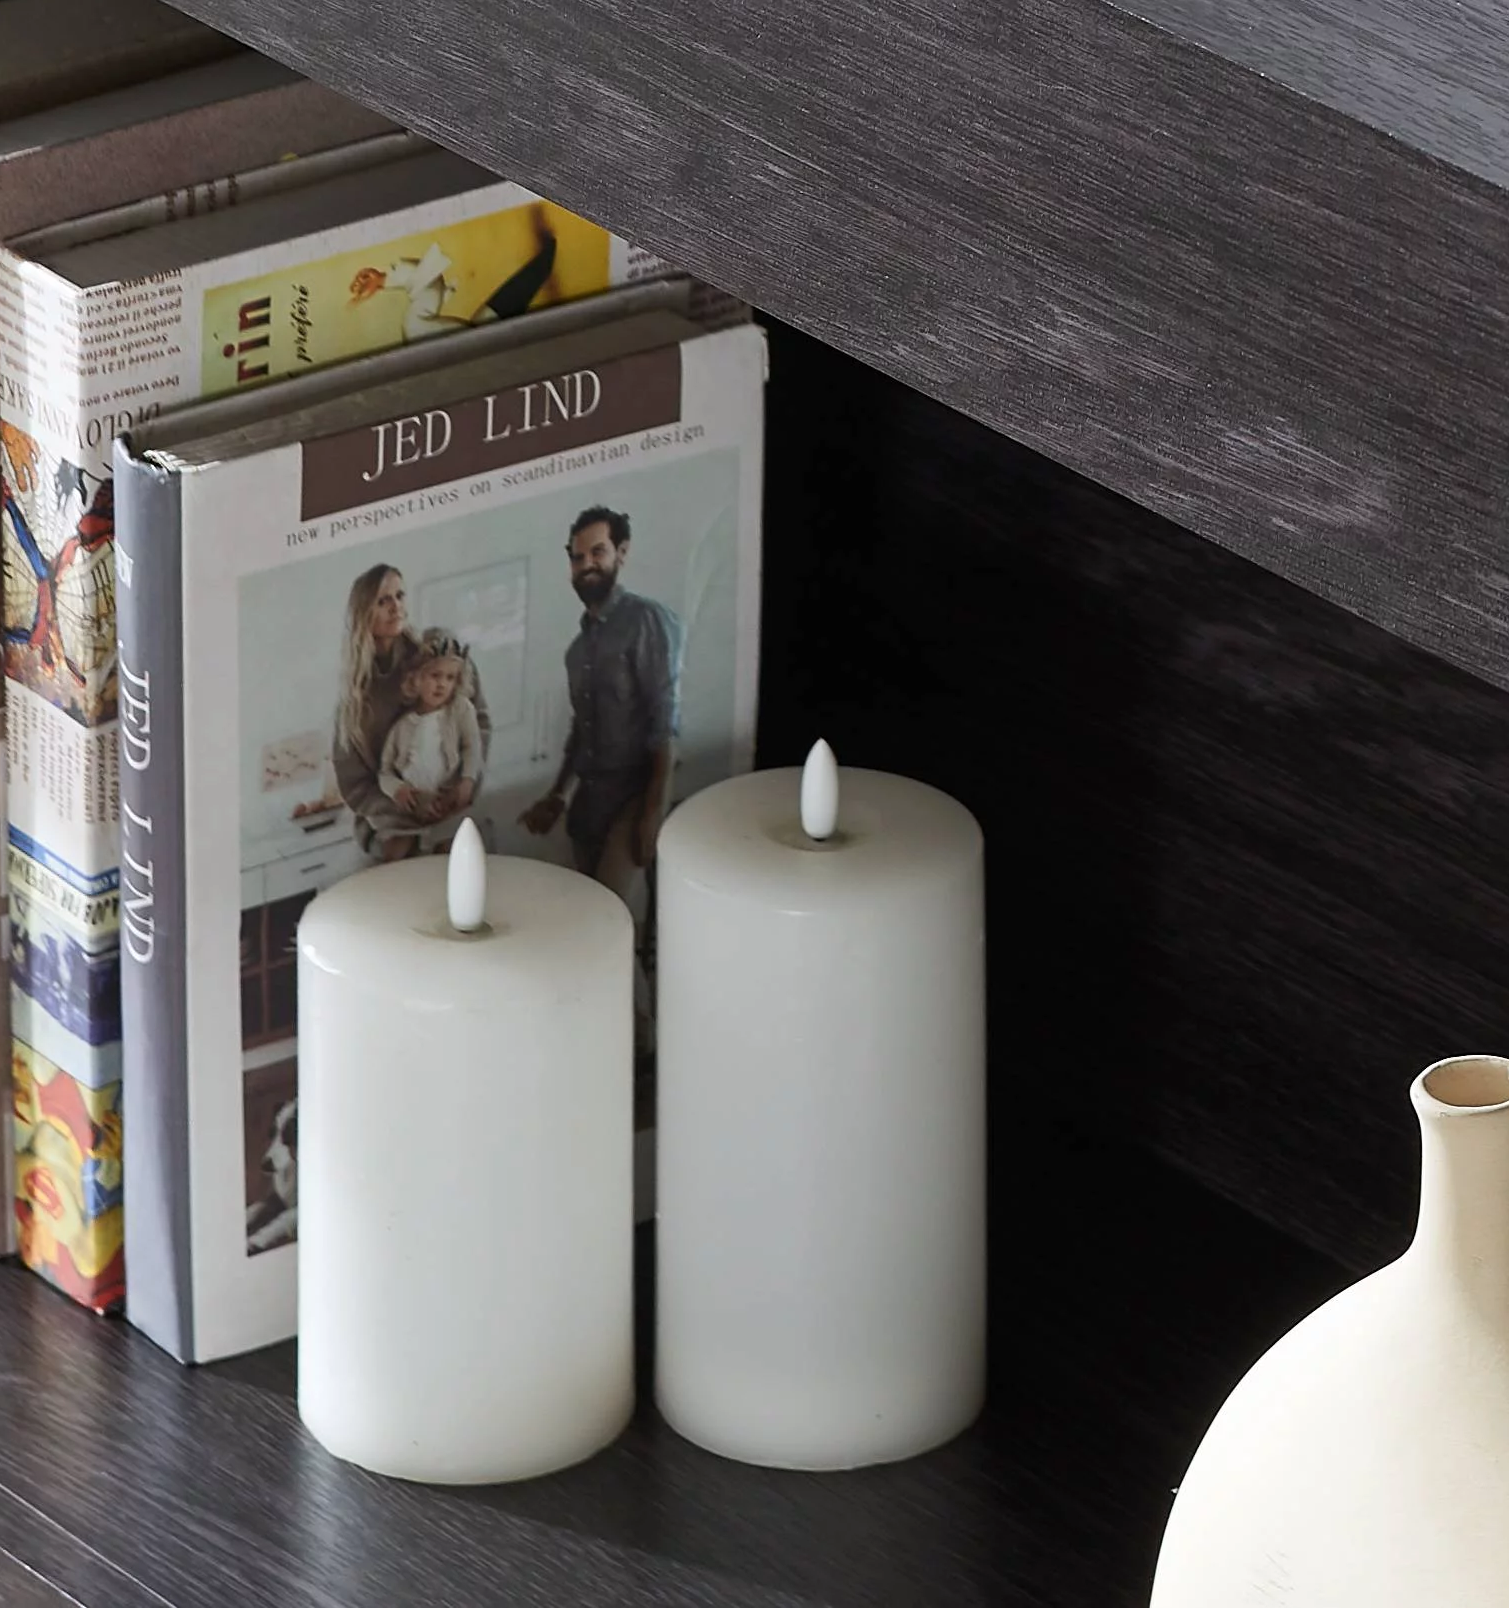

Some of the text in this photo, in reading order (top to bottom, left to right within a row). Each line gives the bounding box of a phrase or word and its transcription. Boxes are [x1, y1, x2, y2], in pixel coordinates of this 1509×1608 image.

[223, 296, 272, 383] rin
[286, 422, 706, 547] new perspectives on scandinavian design
[361, 370, 601, 482] JED LIND
[118, 639, 155, 965] JED LIND
